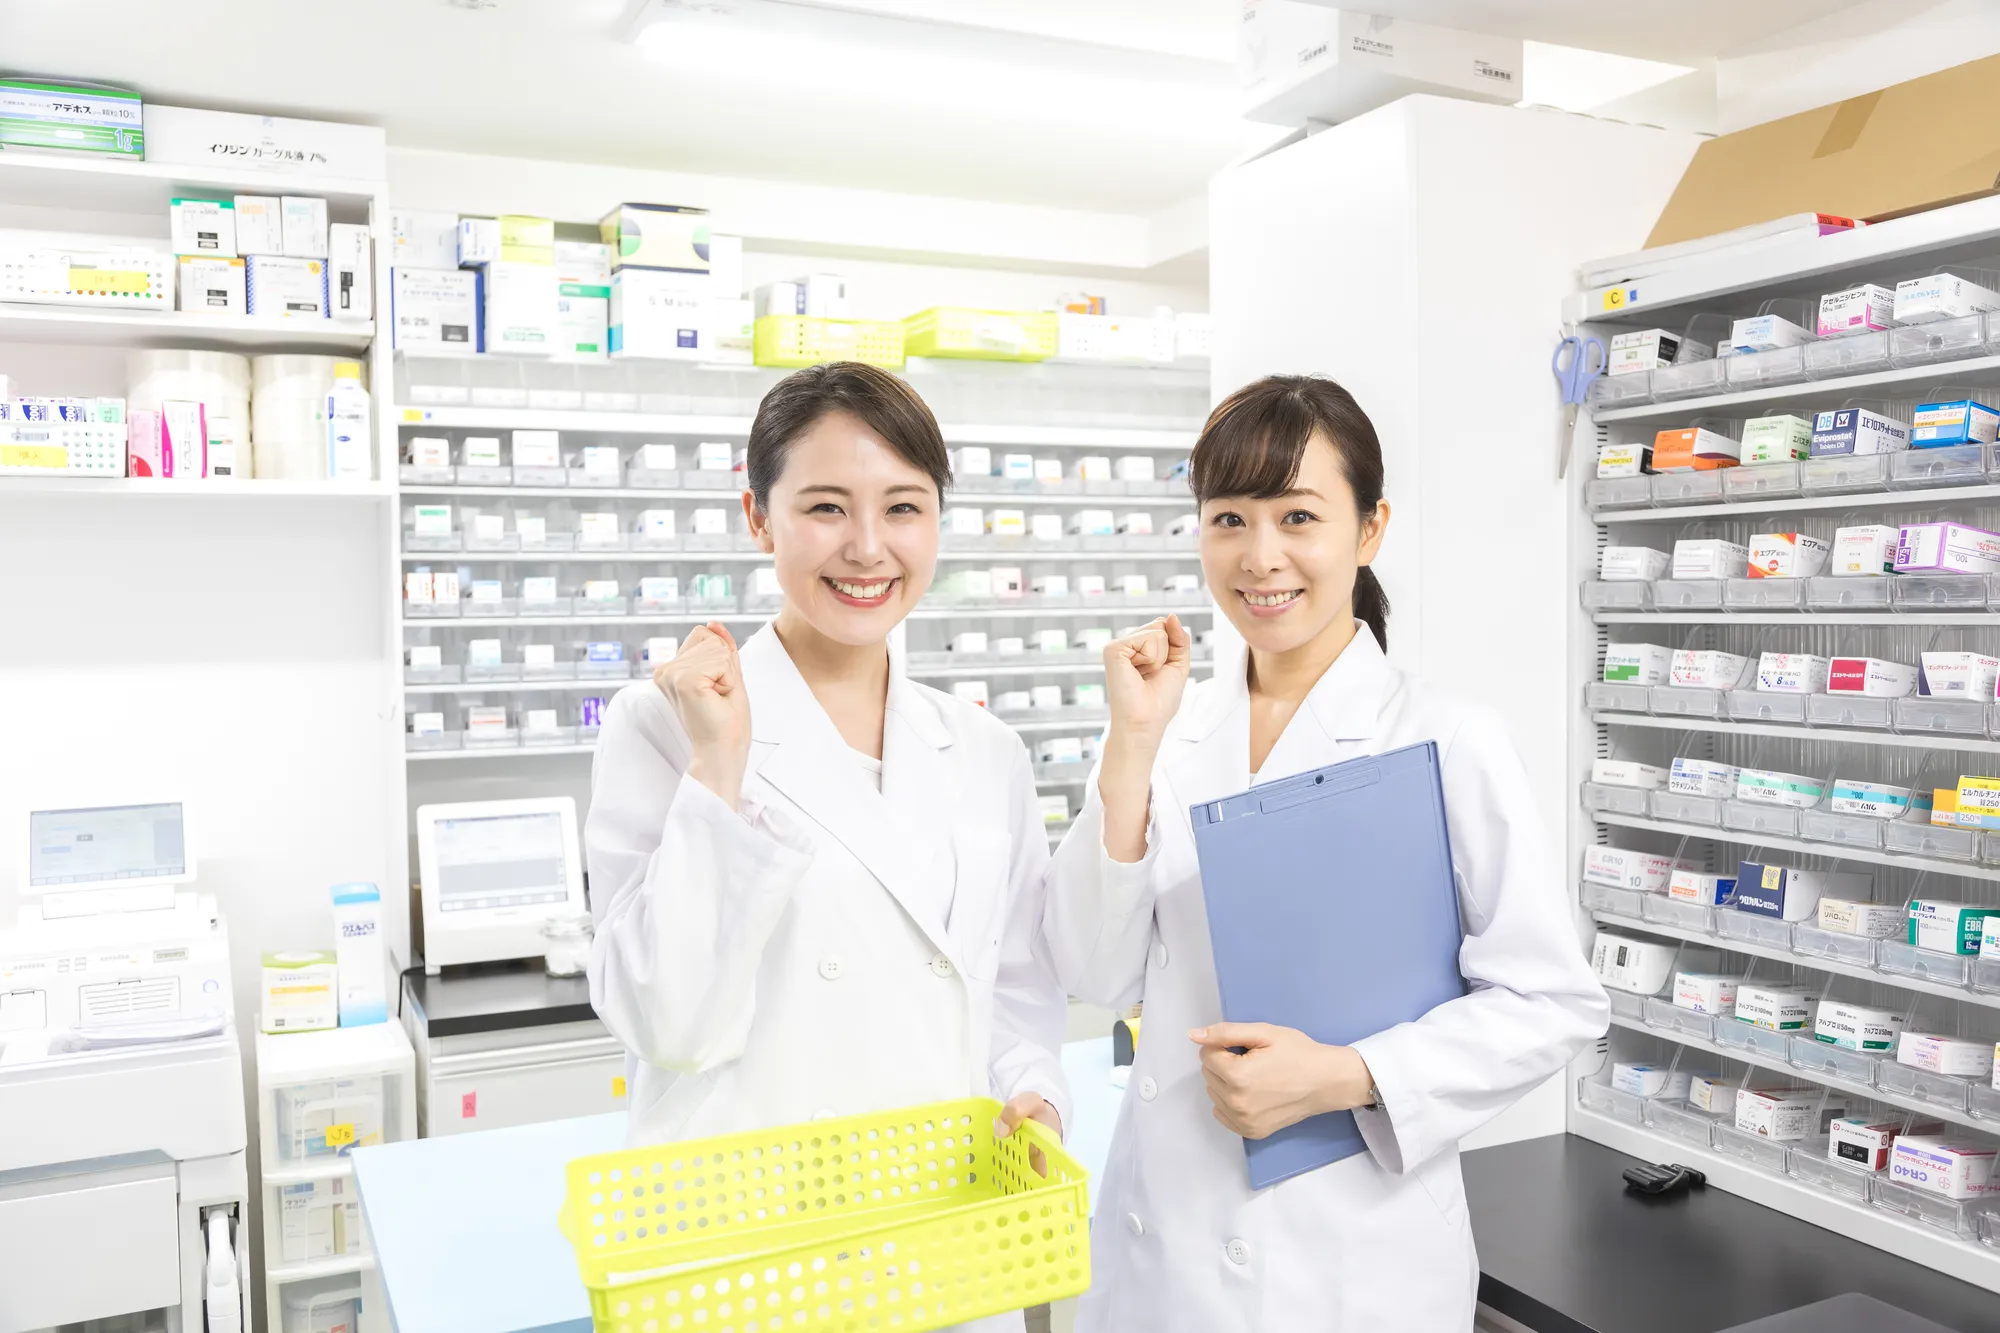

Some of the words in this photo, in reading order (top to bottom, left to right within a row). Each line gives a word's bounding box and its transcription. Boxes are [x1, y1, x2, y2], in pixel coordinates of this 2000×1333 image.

[114, 129, 133, 151] 1g
[1820, 415, 1832, 428] DB
[1813, 431, 1853, 443] Eviprostat
[1898, 548, 1906, 563] 0.75
[1602, 854, 1623, 865] CR10
[1629, 876, 1641, 887] 10
[1894, 1164, 1928, 1182] CR40
